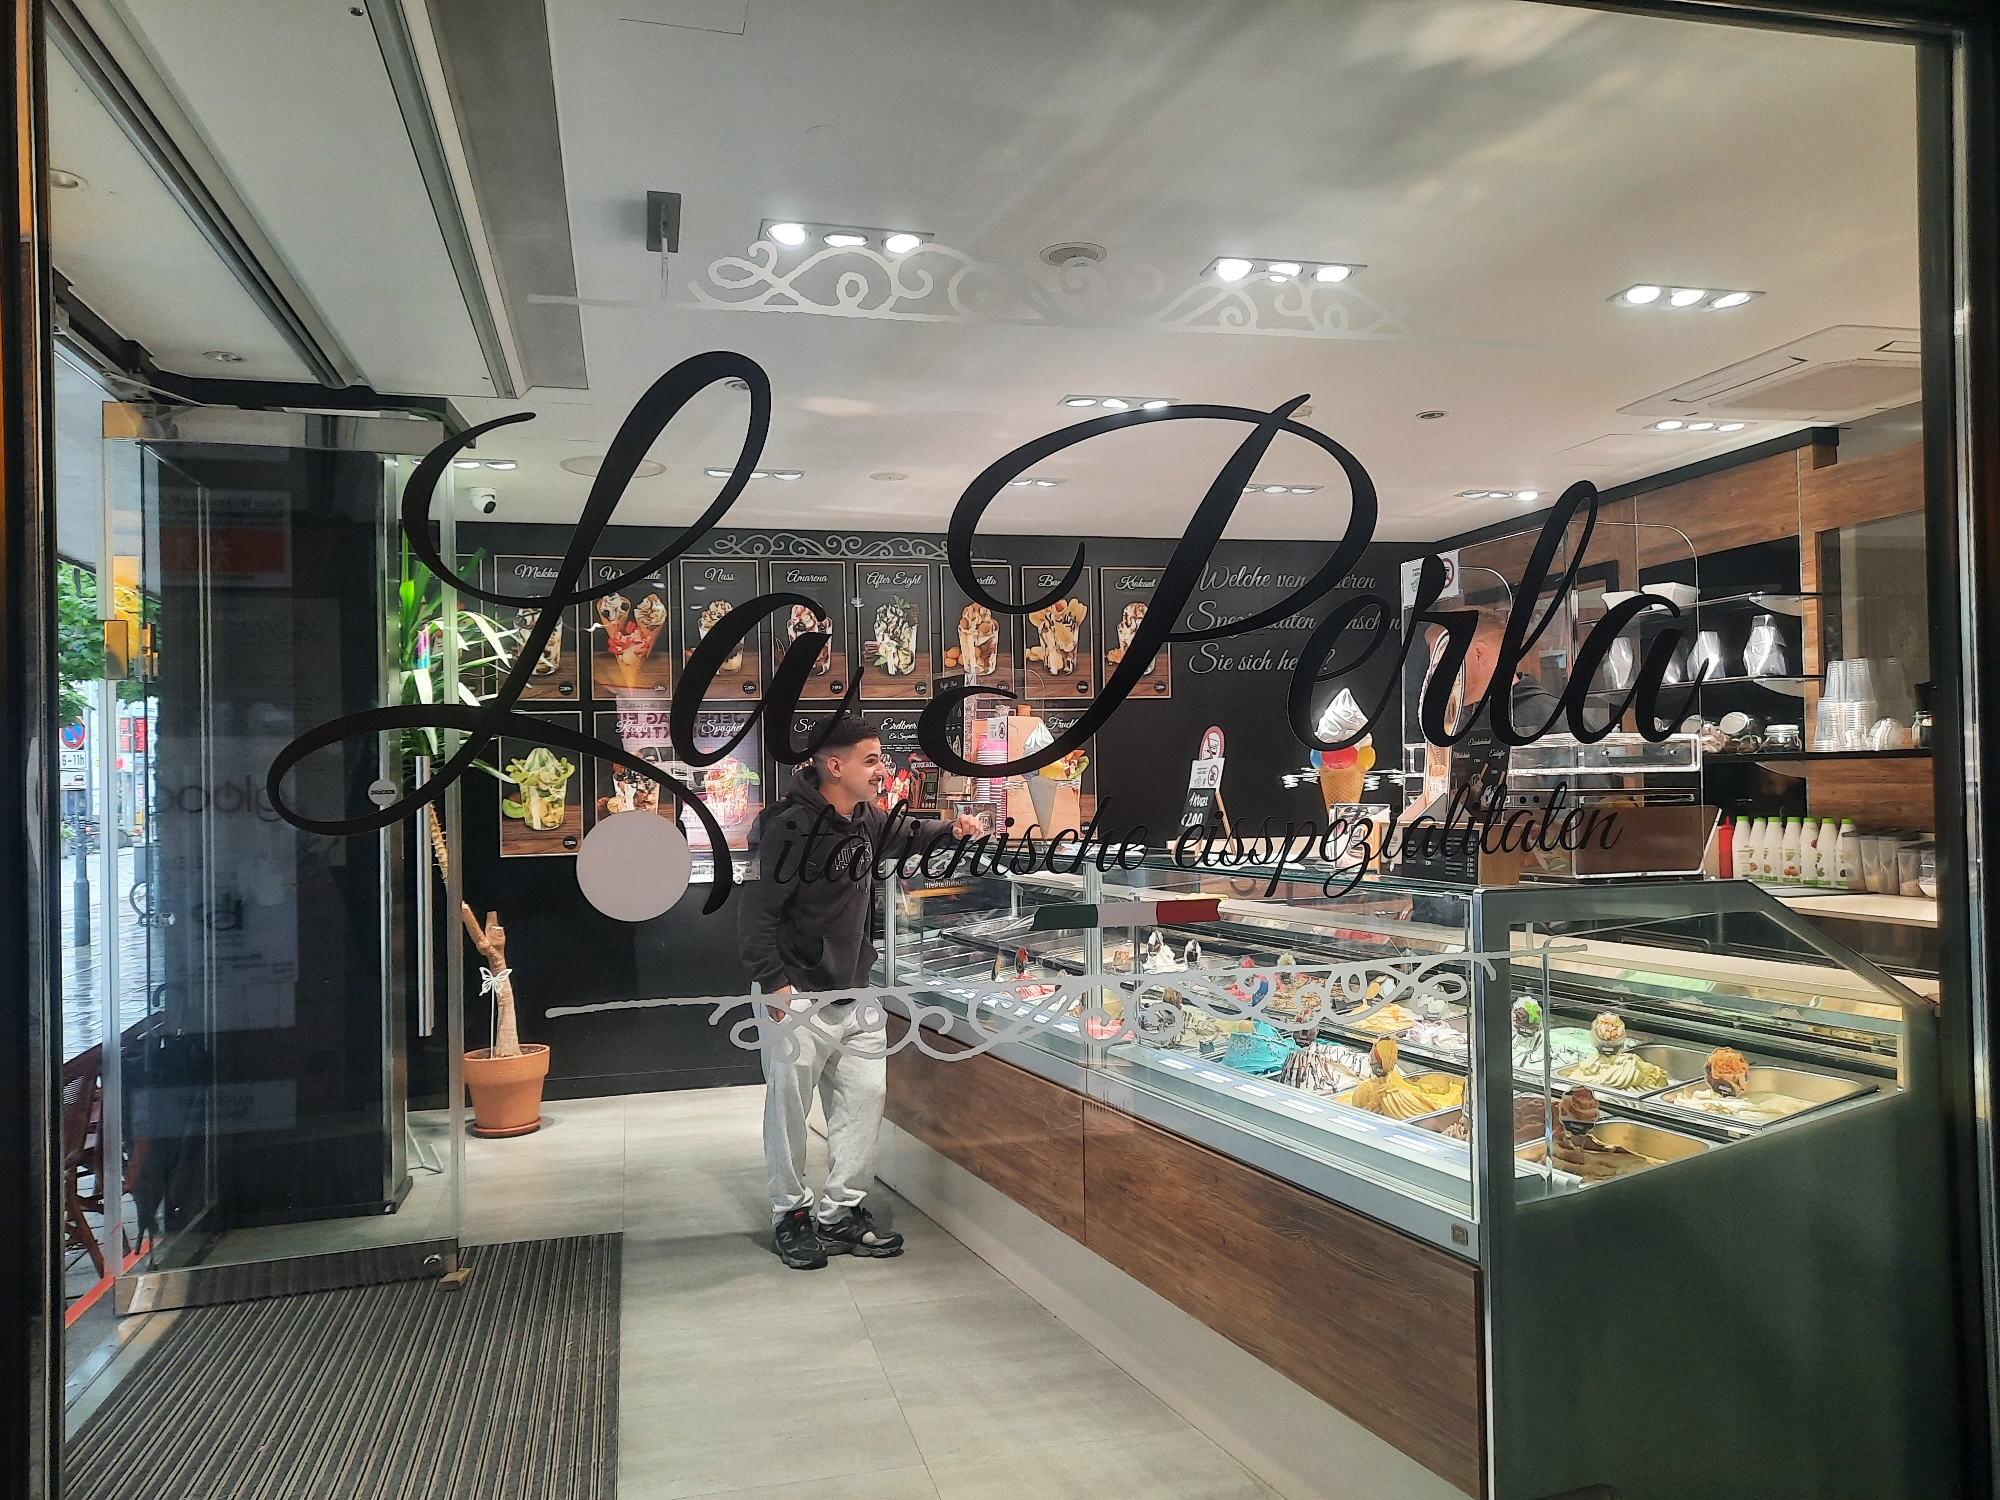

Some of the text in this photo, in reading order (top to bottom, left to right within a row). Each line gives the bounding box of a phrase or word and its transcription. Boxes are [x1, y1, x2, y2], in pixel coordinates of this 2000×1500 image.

[514, 564, 558, 578] Mokka
[704, 567, 735, 582] Nuss
[786, 569, 829, 583] Amarena
[866, 571, 922, 588] After Eight
[1200, 562, 1376, 590] Welche von eren
[1038, 574, 1062, 588] Ban
[1115, 574, 1157, 590] Krokant
[267, 351, 1711, 916] La Perla
[1189, 643, 1234, 674] Sie
[1238, 650, 1273, 671] sich
[701, 719, 746, 737] Spaghet
[773, 781, 1623, 898] italienische eisspezialitäten
